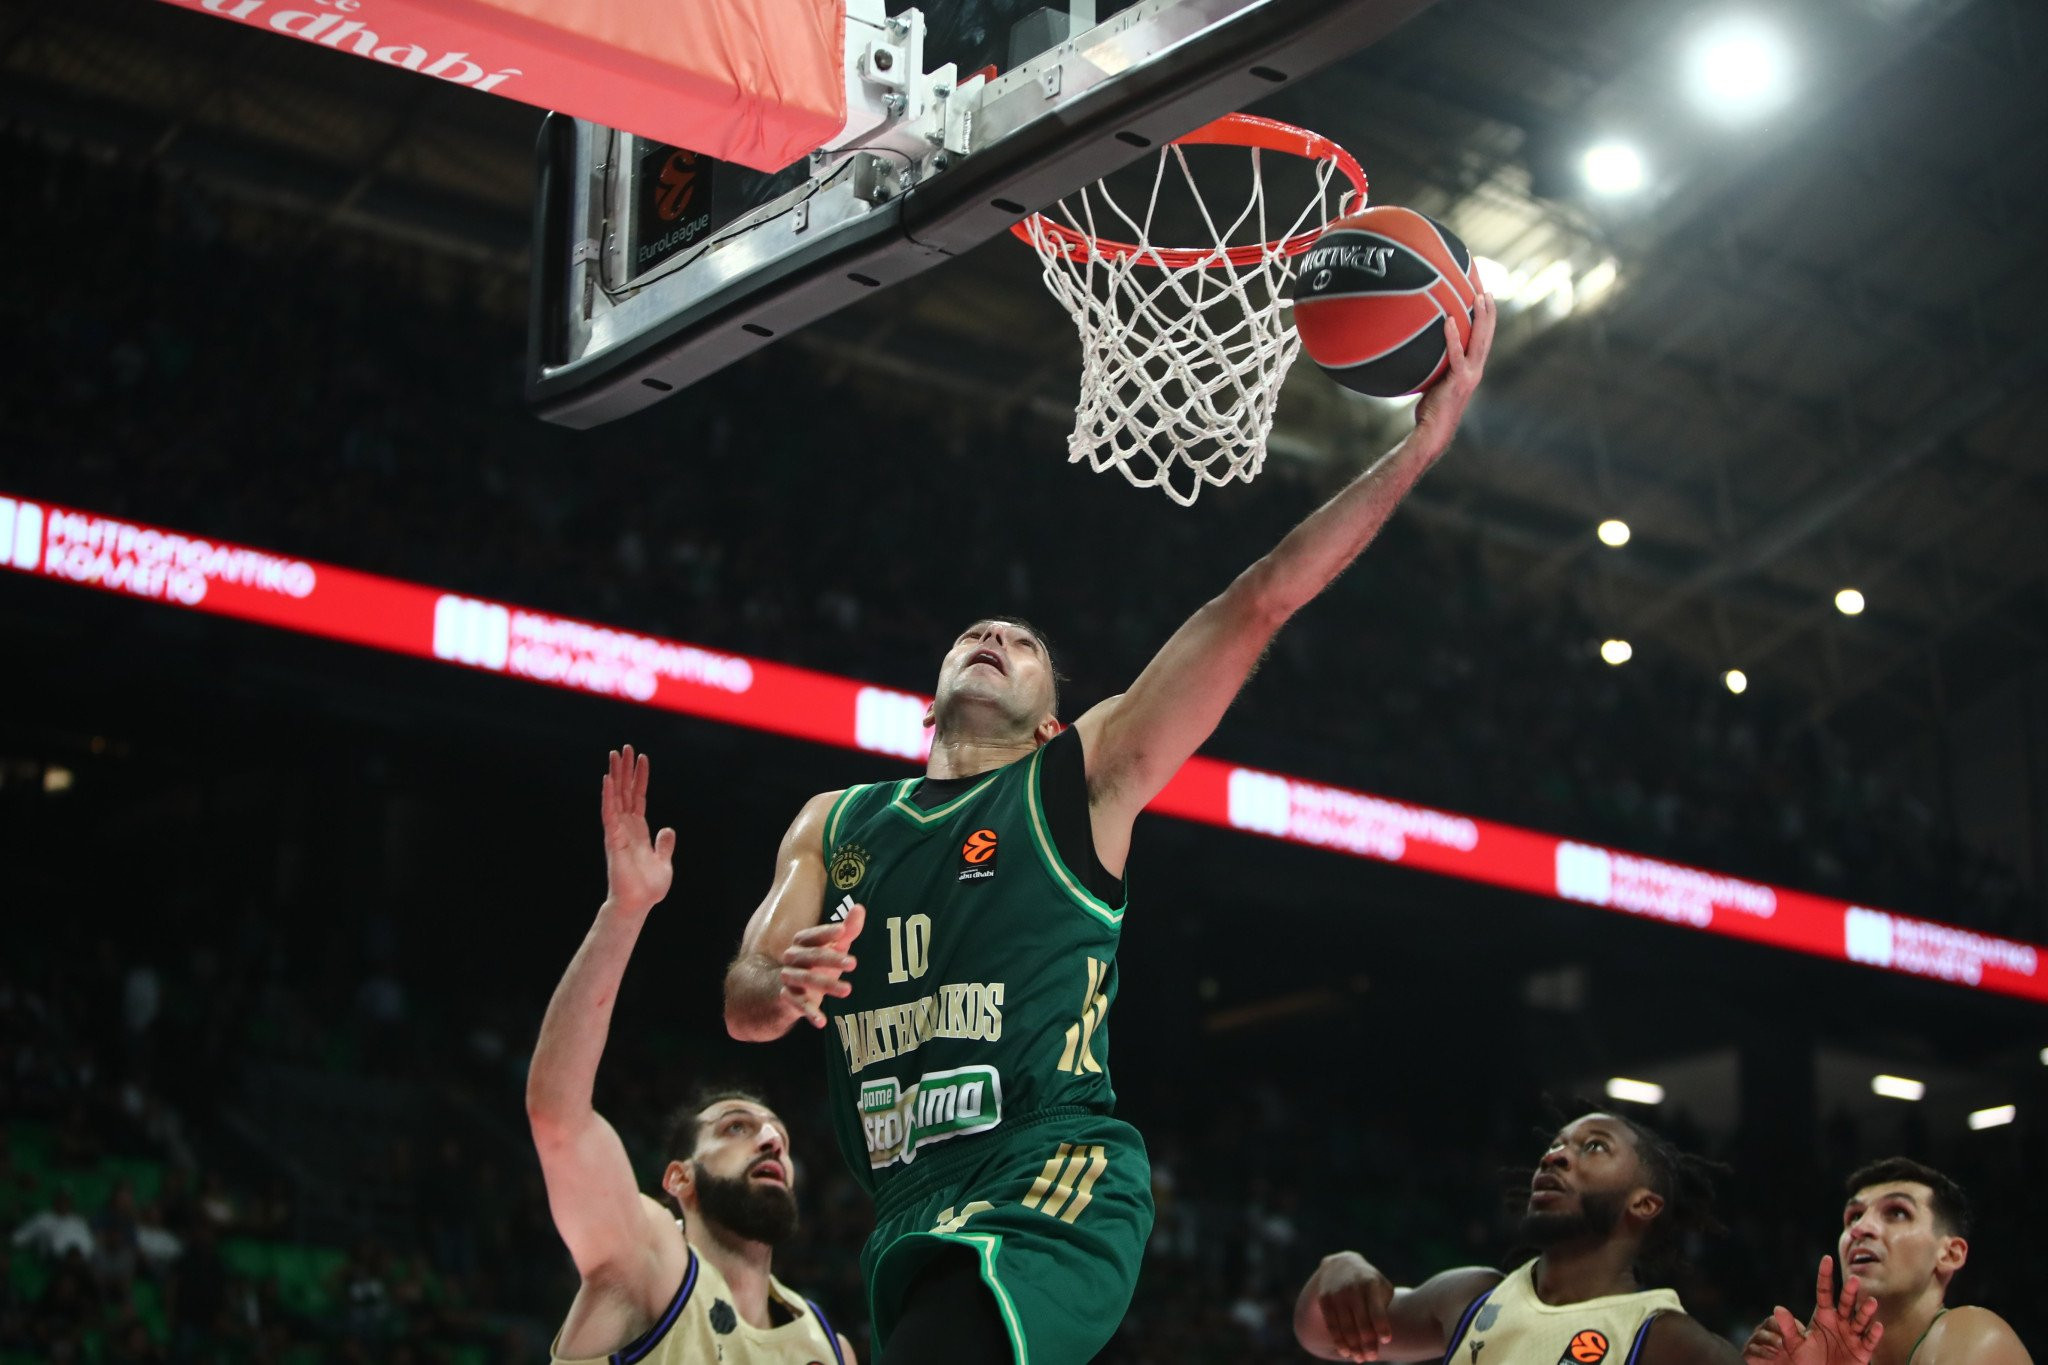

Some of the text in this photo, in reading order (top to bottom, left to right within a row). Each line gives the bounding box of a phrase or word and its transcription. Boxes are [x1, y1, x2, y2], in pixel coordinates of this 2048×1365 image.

[639, 213, 709, 262] EuroLeague
[1299, 245, 1395, 278] SPALDIN
[885, 913, 932, 985] 10
